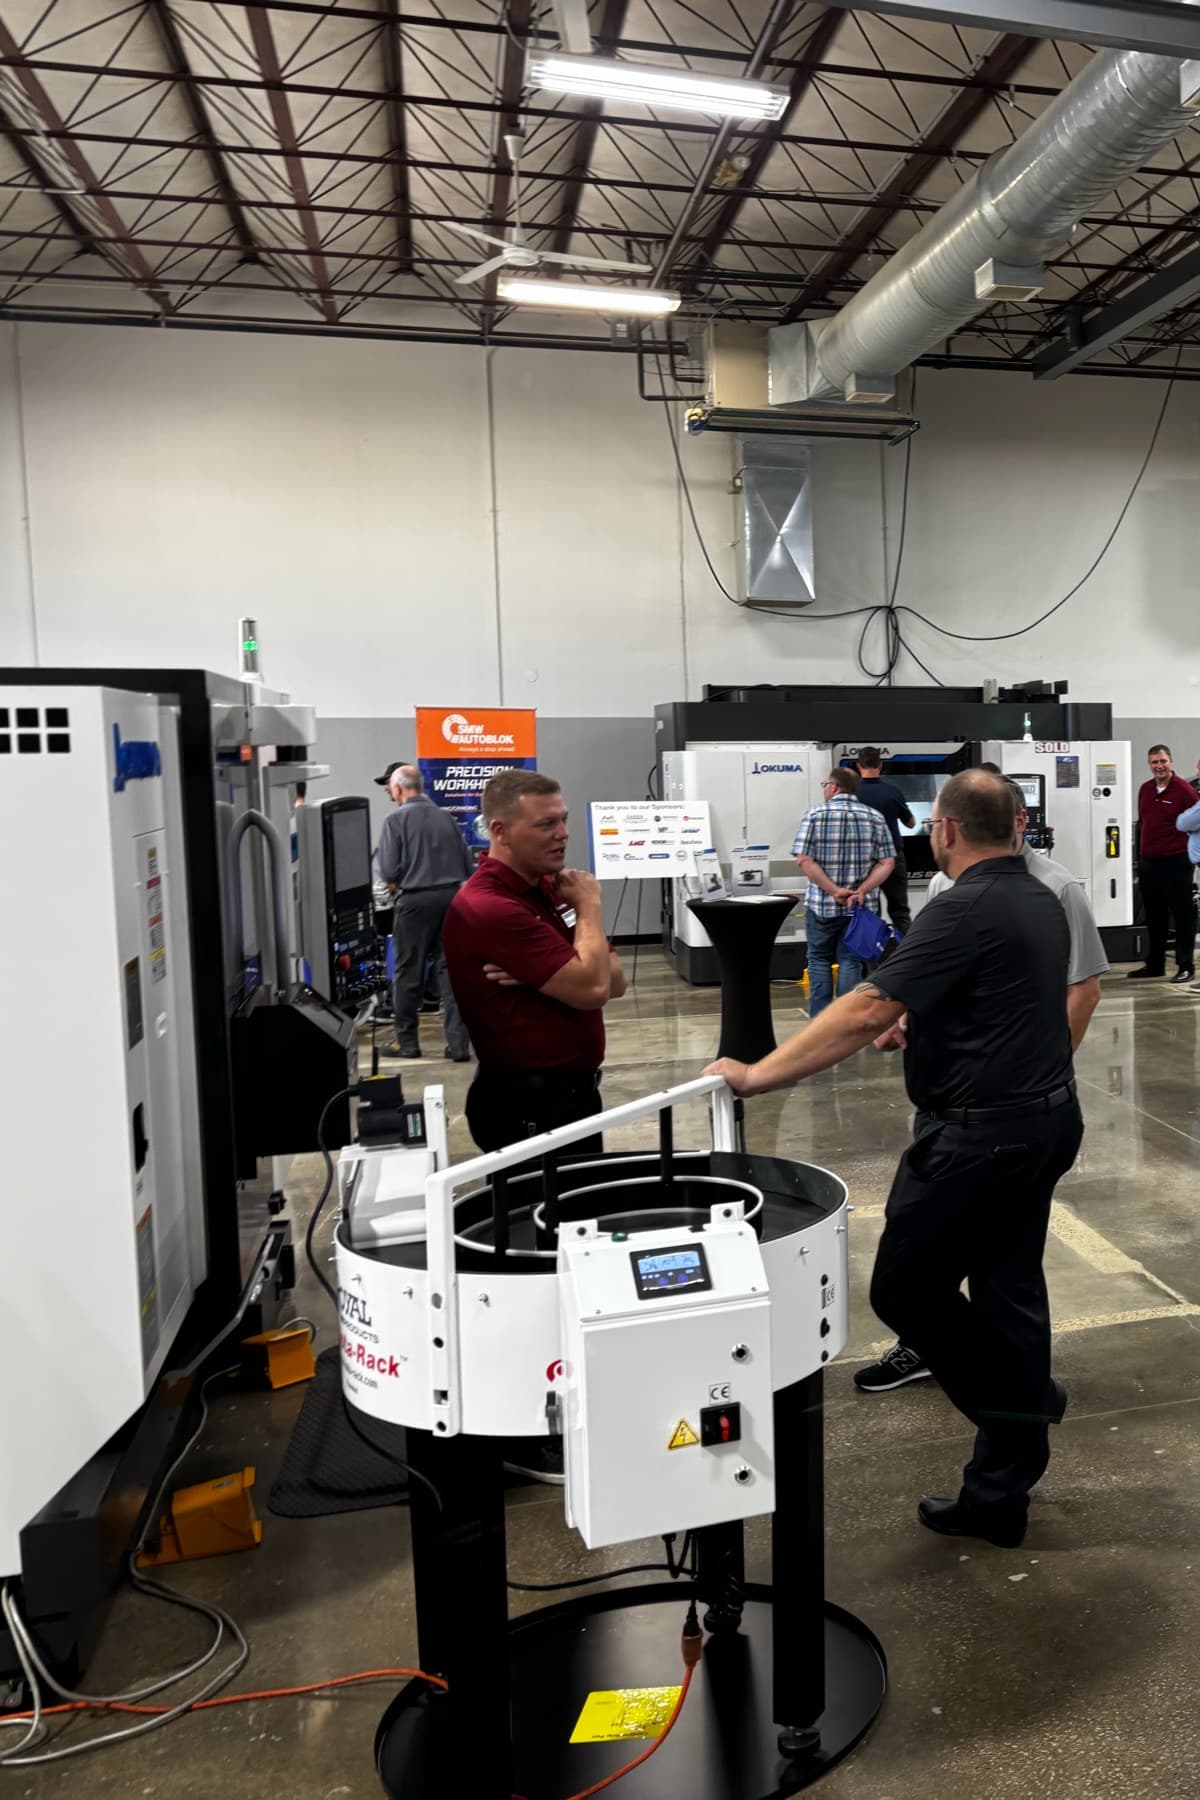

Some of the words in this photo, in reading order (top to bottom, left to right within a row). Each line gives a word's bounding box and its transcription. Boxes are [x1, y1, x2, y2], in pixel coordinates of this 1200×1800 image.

[459, 735, 514, 744] AUTOBLOK
[1035, 742, 1070, 753] SOLD
[761, 764, 802, 772] OKUMA
[711, 1386, 728, 1400] CE
